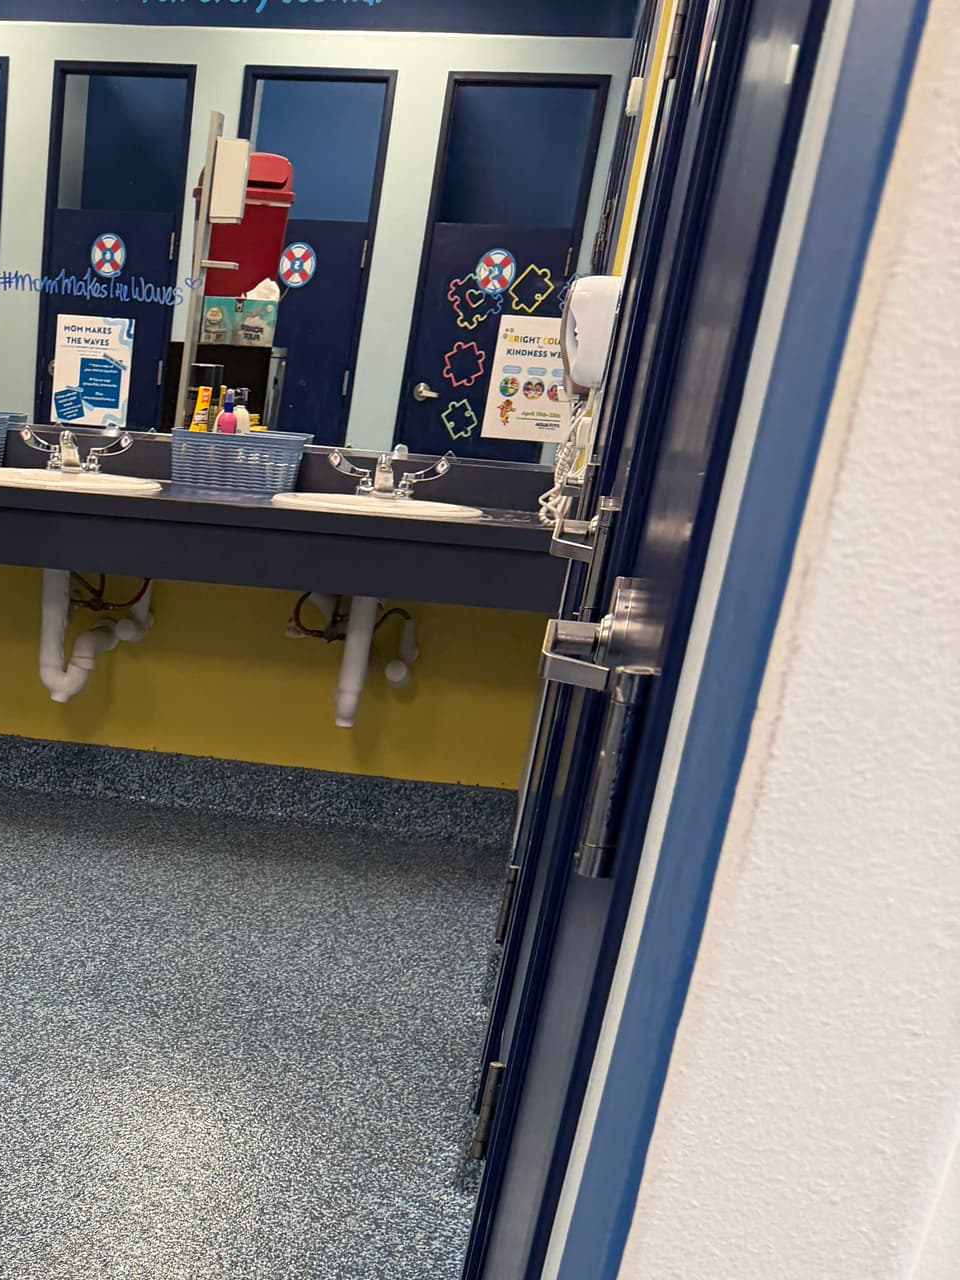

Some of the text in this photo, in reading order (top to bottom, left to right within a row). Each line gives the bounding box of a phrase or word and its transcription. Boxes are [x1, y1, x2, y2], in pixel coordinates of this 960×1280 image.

[85, 327, 112, 335] MAKES
[66, 336, 110, 346] THE WAVES
[507, 335, 561, 345] BRIGHT COL
[506, 348, 562, 359] KINDNESS WE
